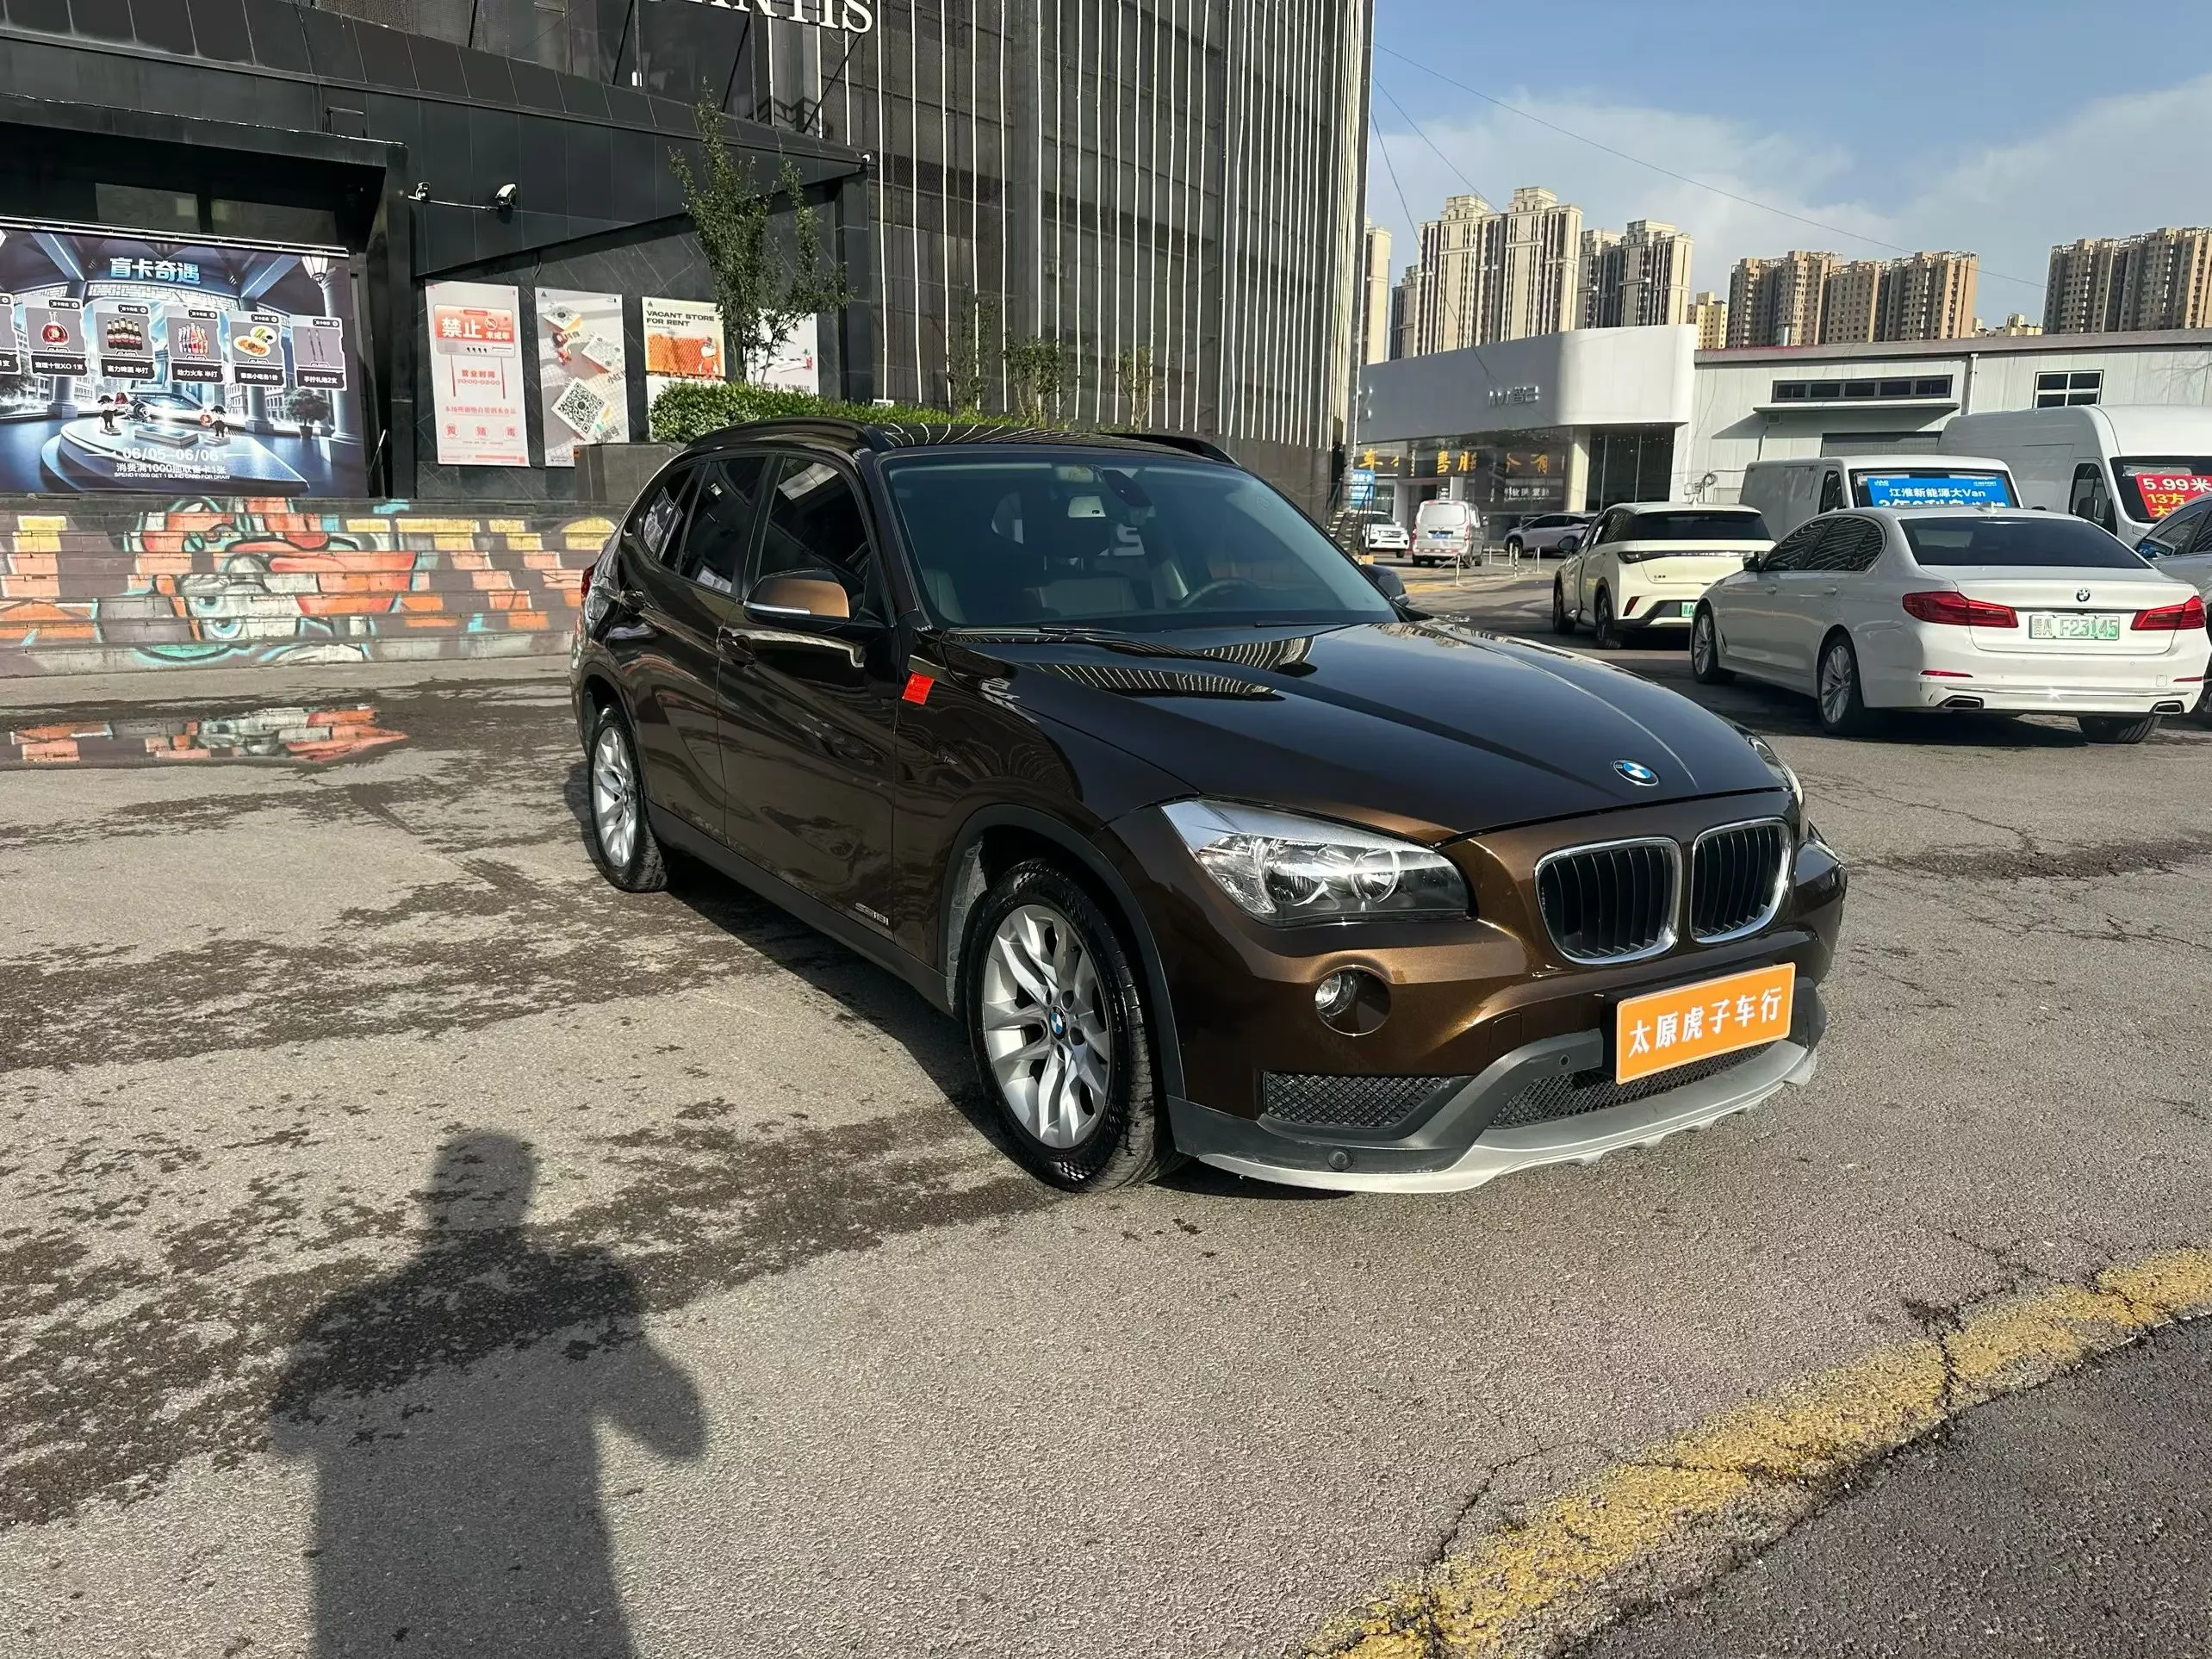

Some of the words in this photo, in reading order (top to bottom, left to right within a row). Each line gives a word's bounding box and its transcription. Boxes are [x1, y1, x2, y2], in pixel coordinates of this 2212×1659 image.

[109, 257, 201, 284] 盲卡奇遇
[646, 310, 682, 319] VACANT
[441, 316, 482, 338] 禁止
[1889, 488, 1986, 498] 江淮新能源大Van
[1628, 986, 1782, 1059] 太原虎子车行
